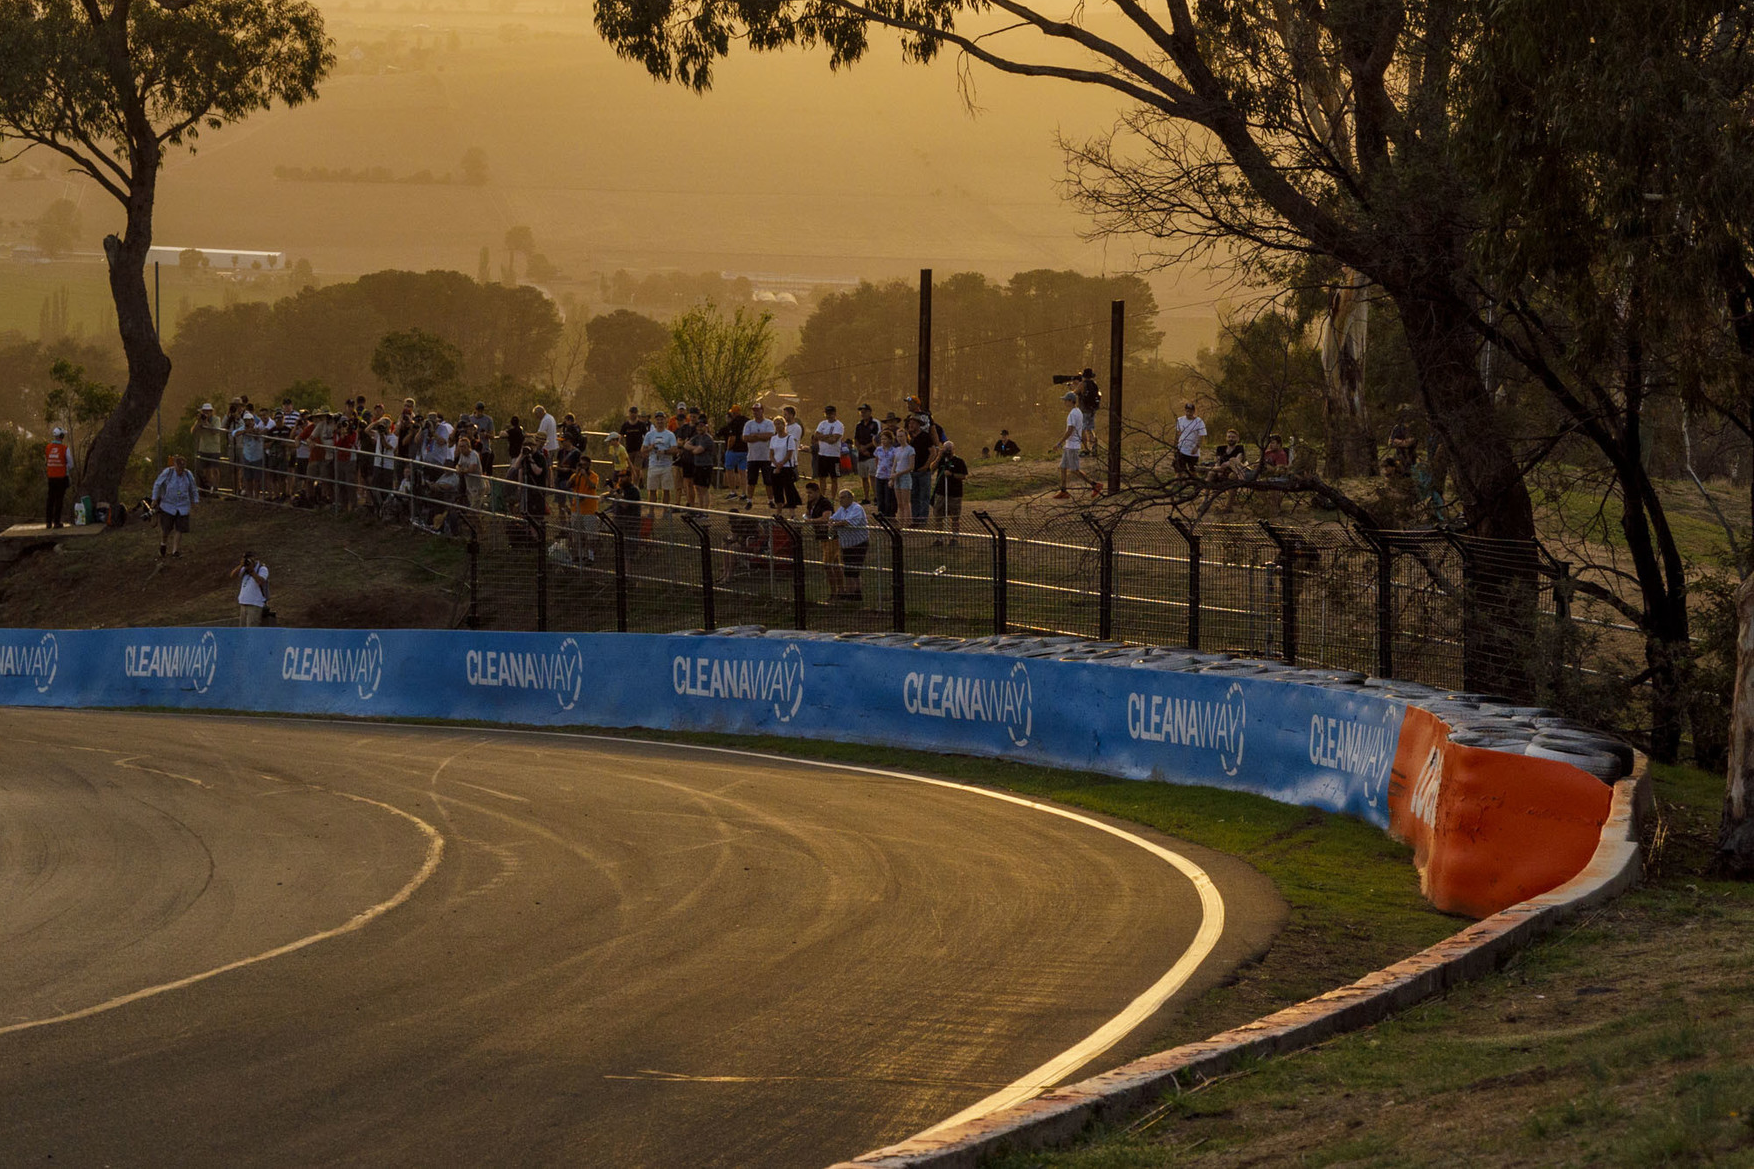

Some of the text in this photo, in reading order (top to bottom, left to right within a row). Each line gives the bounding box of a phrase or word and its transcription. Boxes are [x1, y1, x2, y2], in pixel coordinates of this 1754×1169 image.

[126, 645, 212, 678] CLEANAWAY
[282, 646, 377, 683] CLEANAWAY
[466, 649, 577, 691] CLEANAWAY
[673, 655, 798, 702] CLEANAWAY
[903, 672, 1026, 725] CLEANAWAY
[1128, 692, 1240, 753] CLEANAWAY
[1309, 714, 1391, 780] CLEANAWAY
